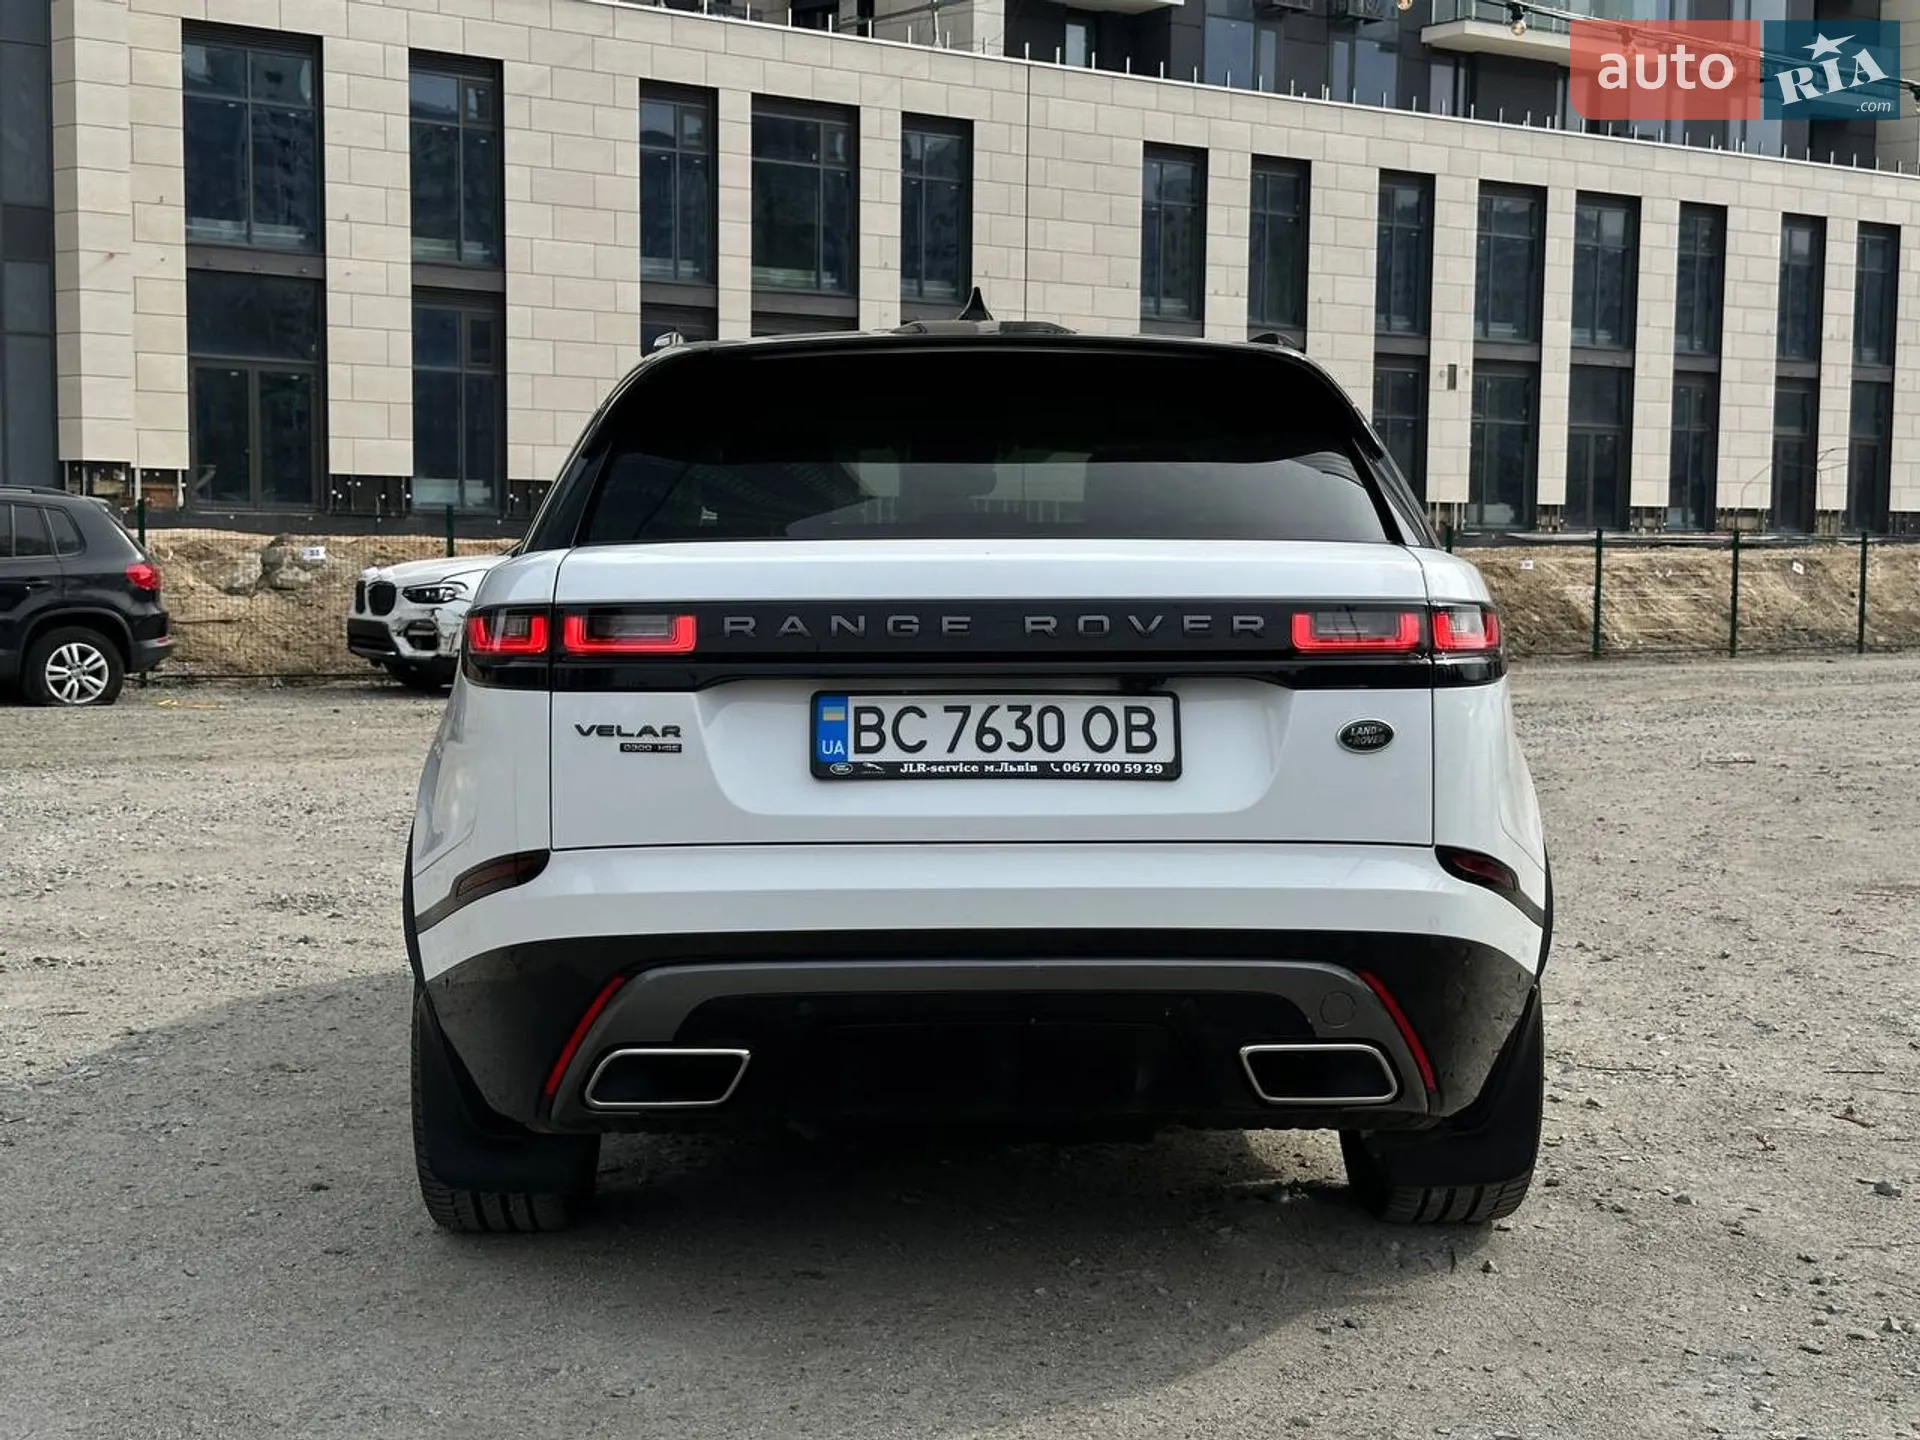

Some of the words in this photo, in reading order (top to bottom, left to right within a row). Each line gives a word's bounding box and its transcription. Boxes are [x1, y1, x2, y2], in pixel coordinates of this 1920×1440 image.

[722, 614, 972, 638] RANGE
[1024, 614, 1266, 638] ROVER
[574, 724, 681, 738] VELAR
[853, 705, 927, 754] BC
[943, 705, 1065, 754] 7630
[1082, 705, 1157, 754] OB
[1351, 726, 1377, 736] LAND
[822, 740, 844, 755] UA
[900, 763, 979, 773] JLR-service
[1063, 763, 1090, 773] 067
[1094, 763, 1121, 774] 700
[1124, 763, 1142, 774] 59
[1145, 763, 1163, 774] 29
